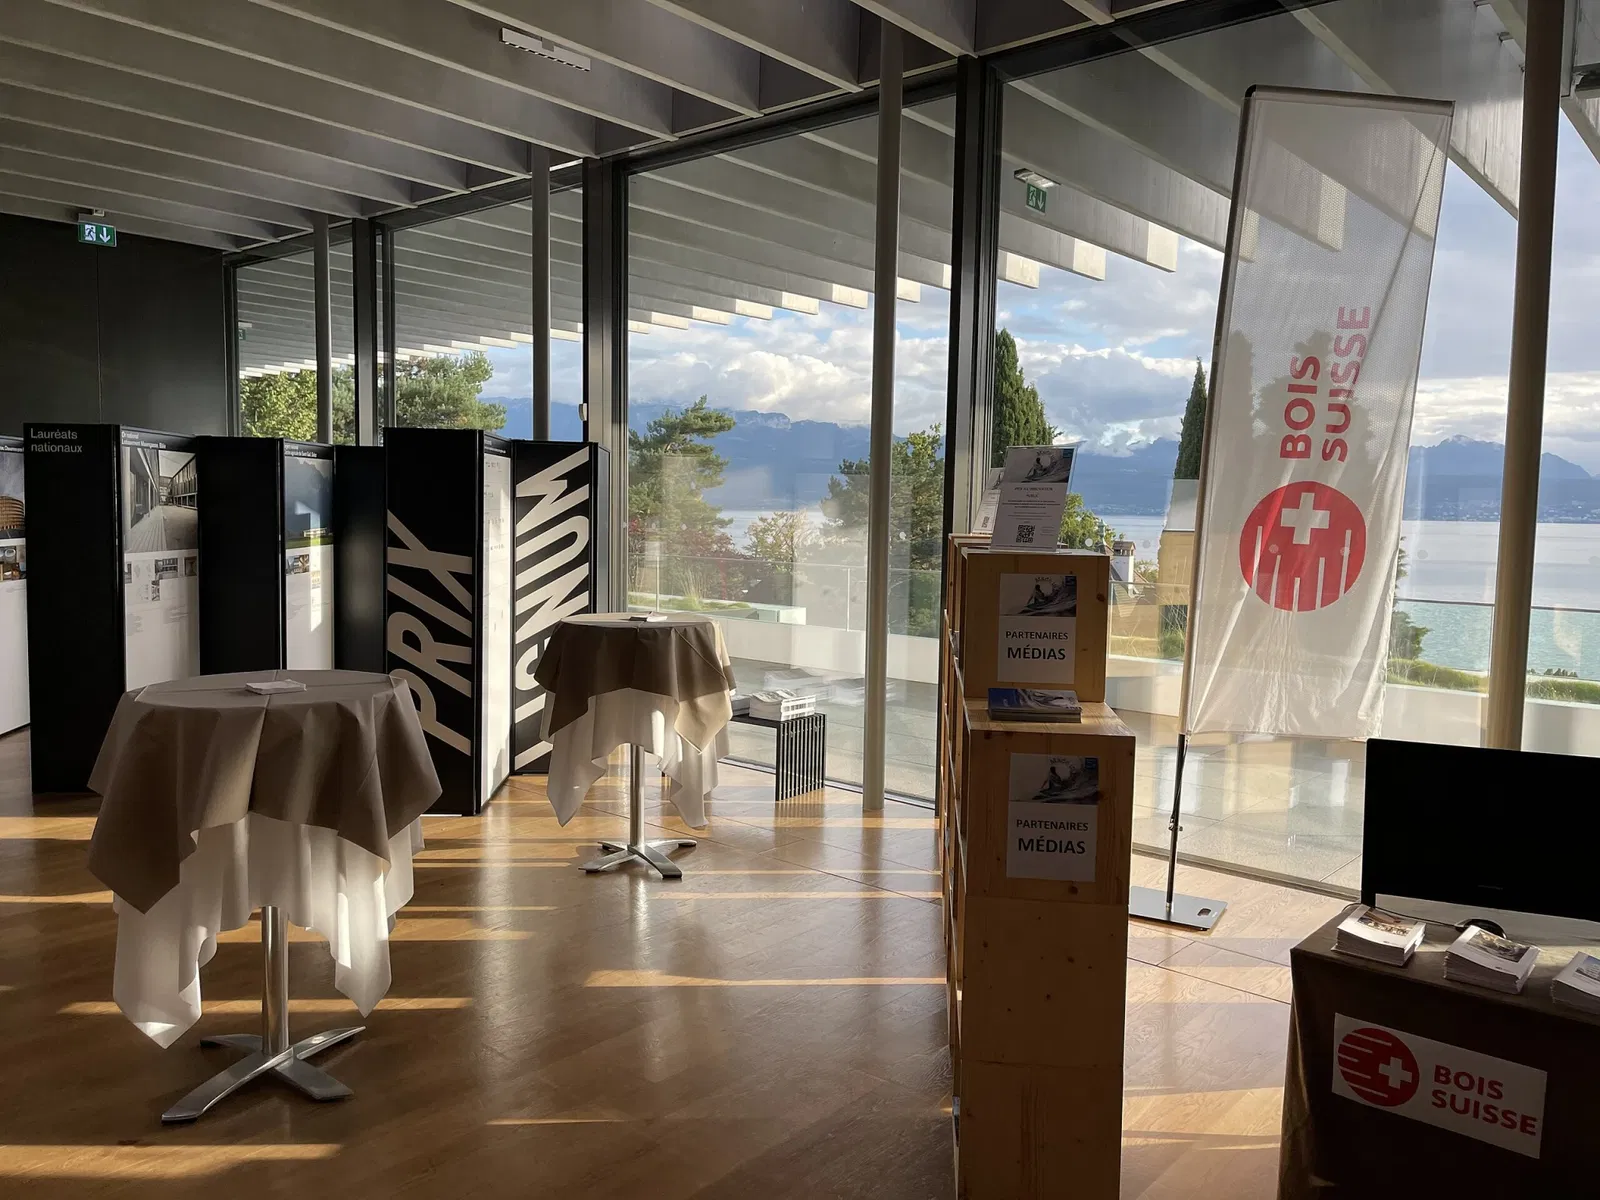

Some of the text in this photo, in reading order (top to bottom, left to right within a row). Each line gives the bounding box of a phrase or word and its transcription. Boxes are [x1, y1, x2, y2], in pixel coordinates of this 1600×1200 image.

[1321, 306, 1371, 463] SUISSE
[1280, 355, 1321, 460] BOIS
[30, 428, 78, 439] Lauréats
[30, 442, 83, 453] nationaux
[387, 509, 472, 757] PRIX
[1005, 630, 1069, 640] PARTENAIRES
[1007, 644, 1066, 661] MÉDIAS
[1016, 819, 1089, 831] PARTENAIRES
[1018, 836, 1086, 854] MÉDIAS
[1434, 1064, 1504, 1100] BOIS
[1431, 1089, 1538, 1137] SUISSE
